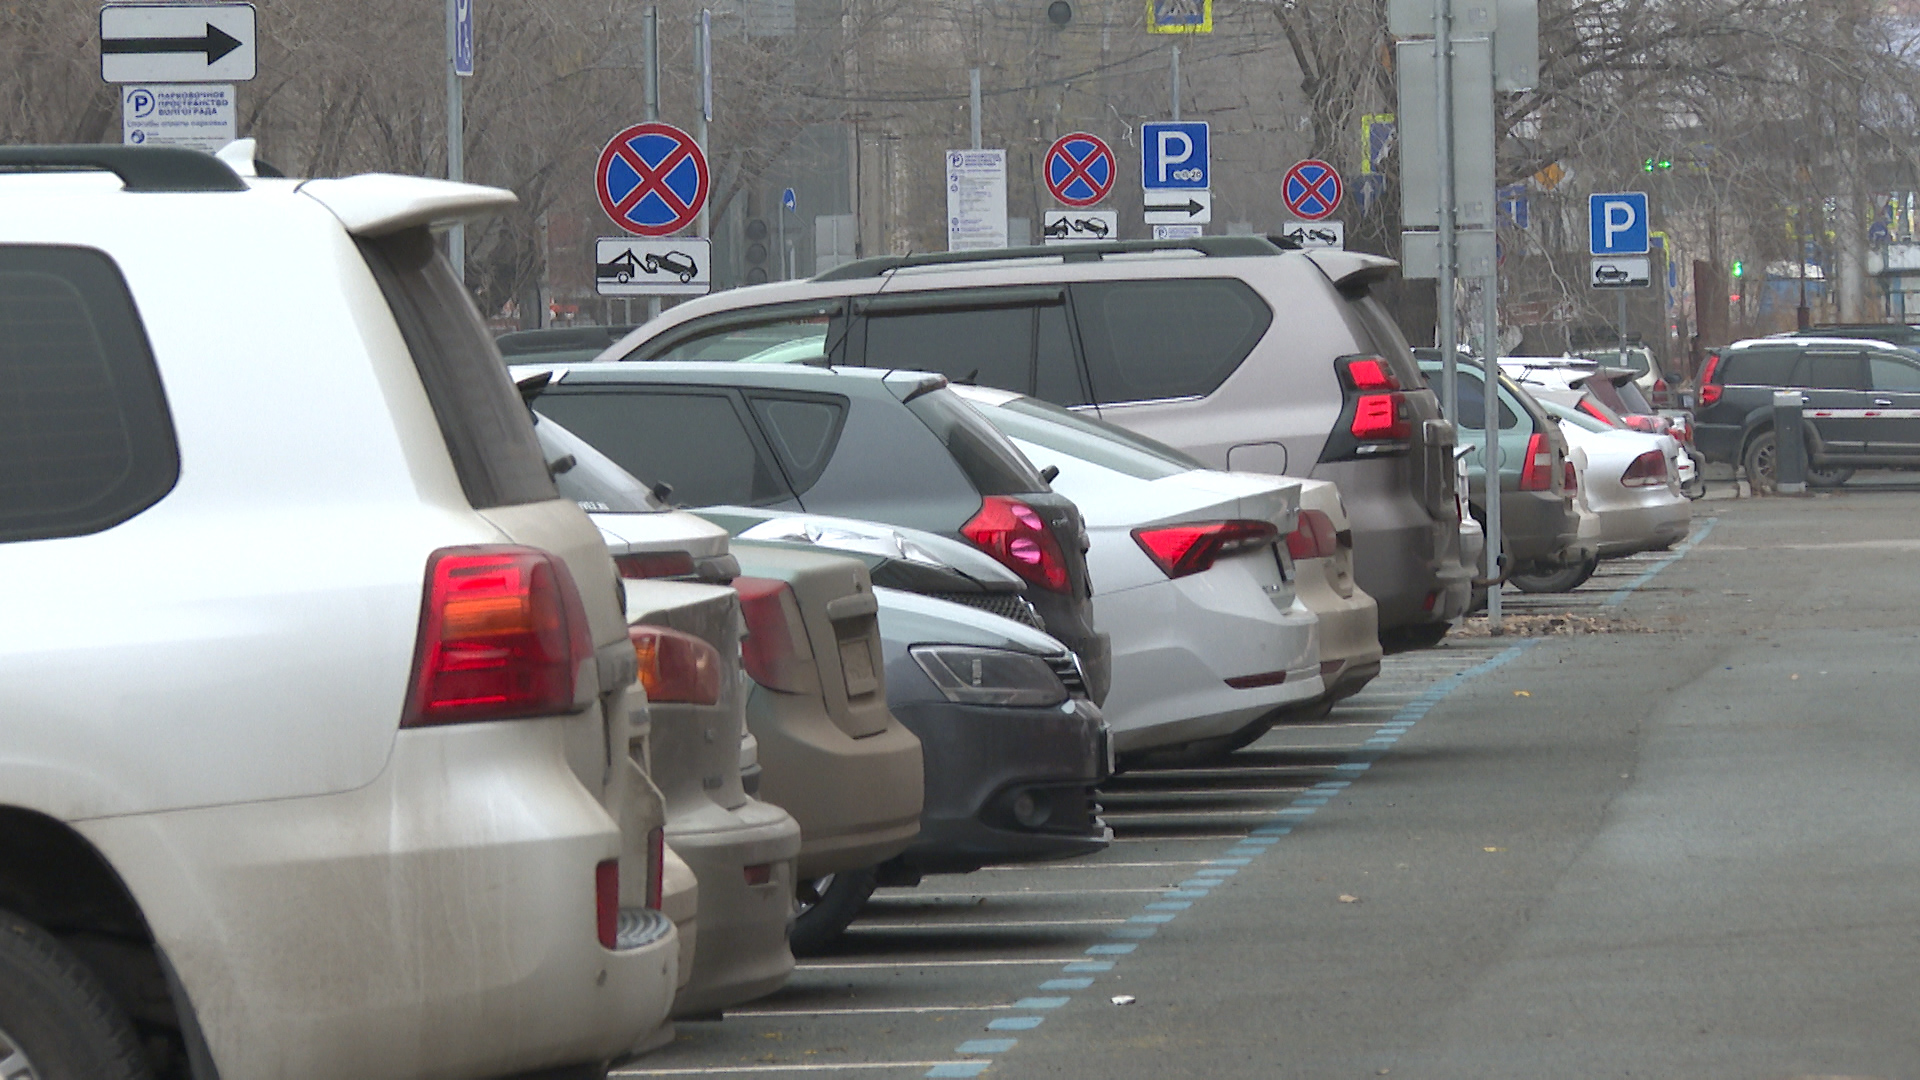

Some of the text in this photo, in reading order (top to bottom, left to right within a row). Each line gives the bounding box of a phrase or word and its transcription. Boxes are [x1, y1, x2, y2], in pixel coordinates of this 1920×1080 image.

[135, 95, 149, 112] P
[1158, 131, 1193, 181] P
[1604, 201, 1636, 248] P
